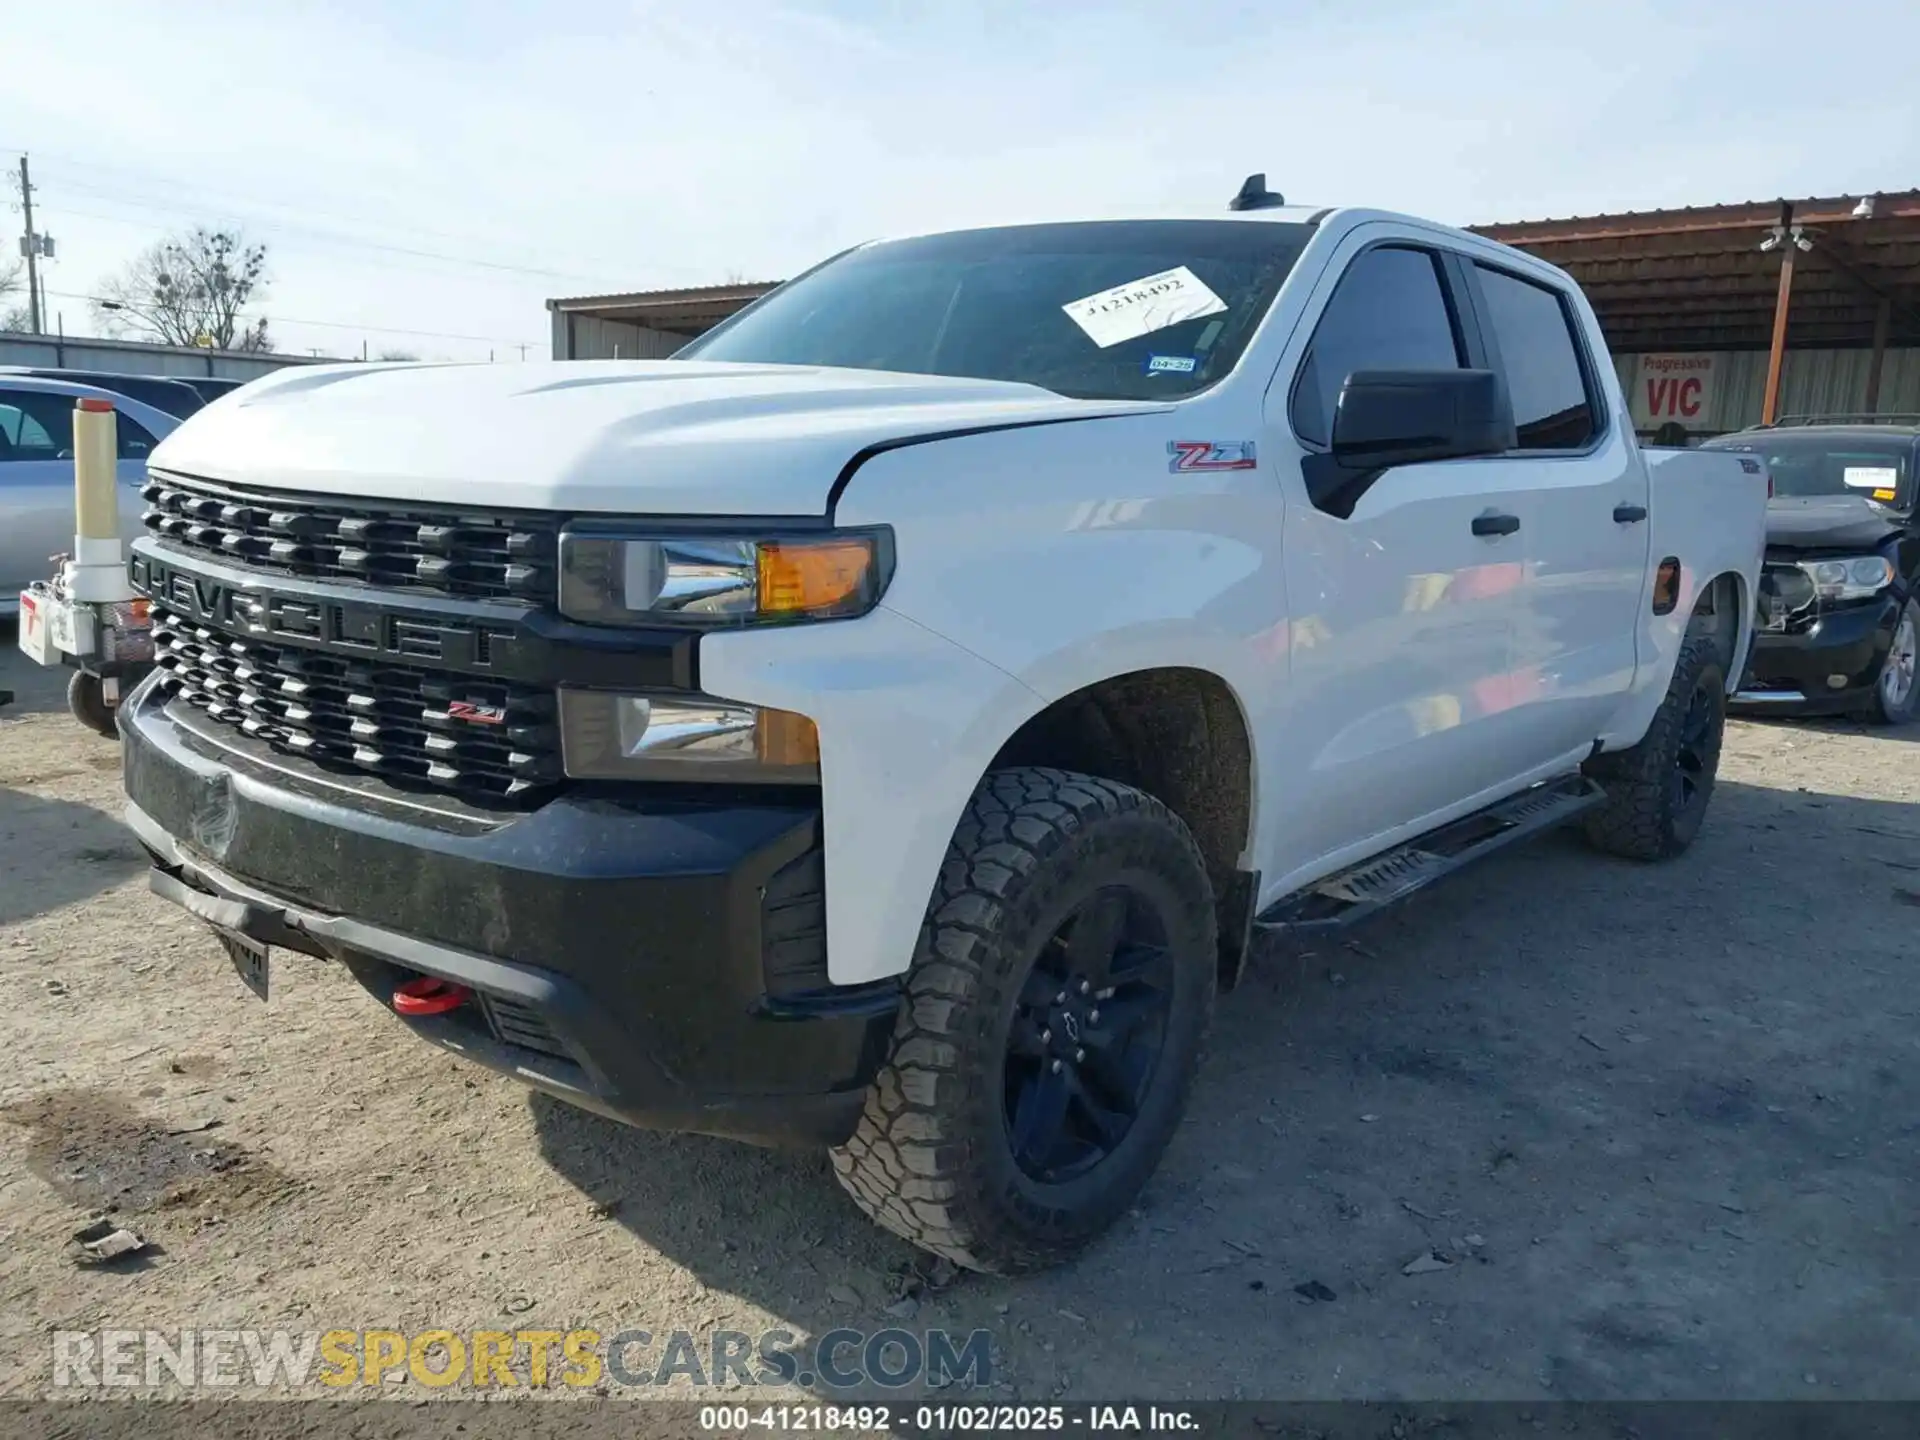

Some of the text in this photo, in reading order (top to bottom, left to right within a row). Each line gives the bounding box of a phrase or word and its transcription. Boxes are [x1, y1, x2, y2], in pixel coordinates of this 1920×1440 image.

[1643, 356, 1711, 373] Progressive
[1647, 378, 1703, 417] VIC
[130, 554, 517, 666] CHEVROLET
